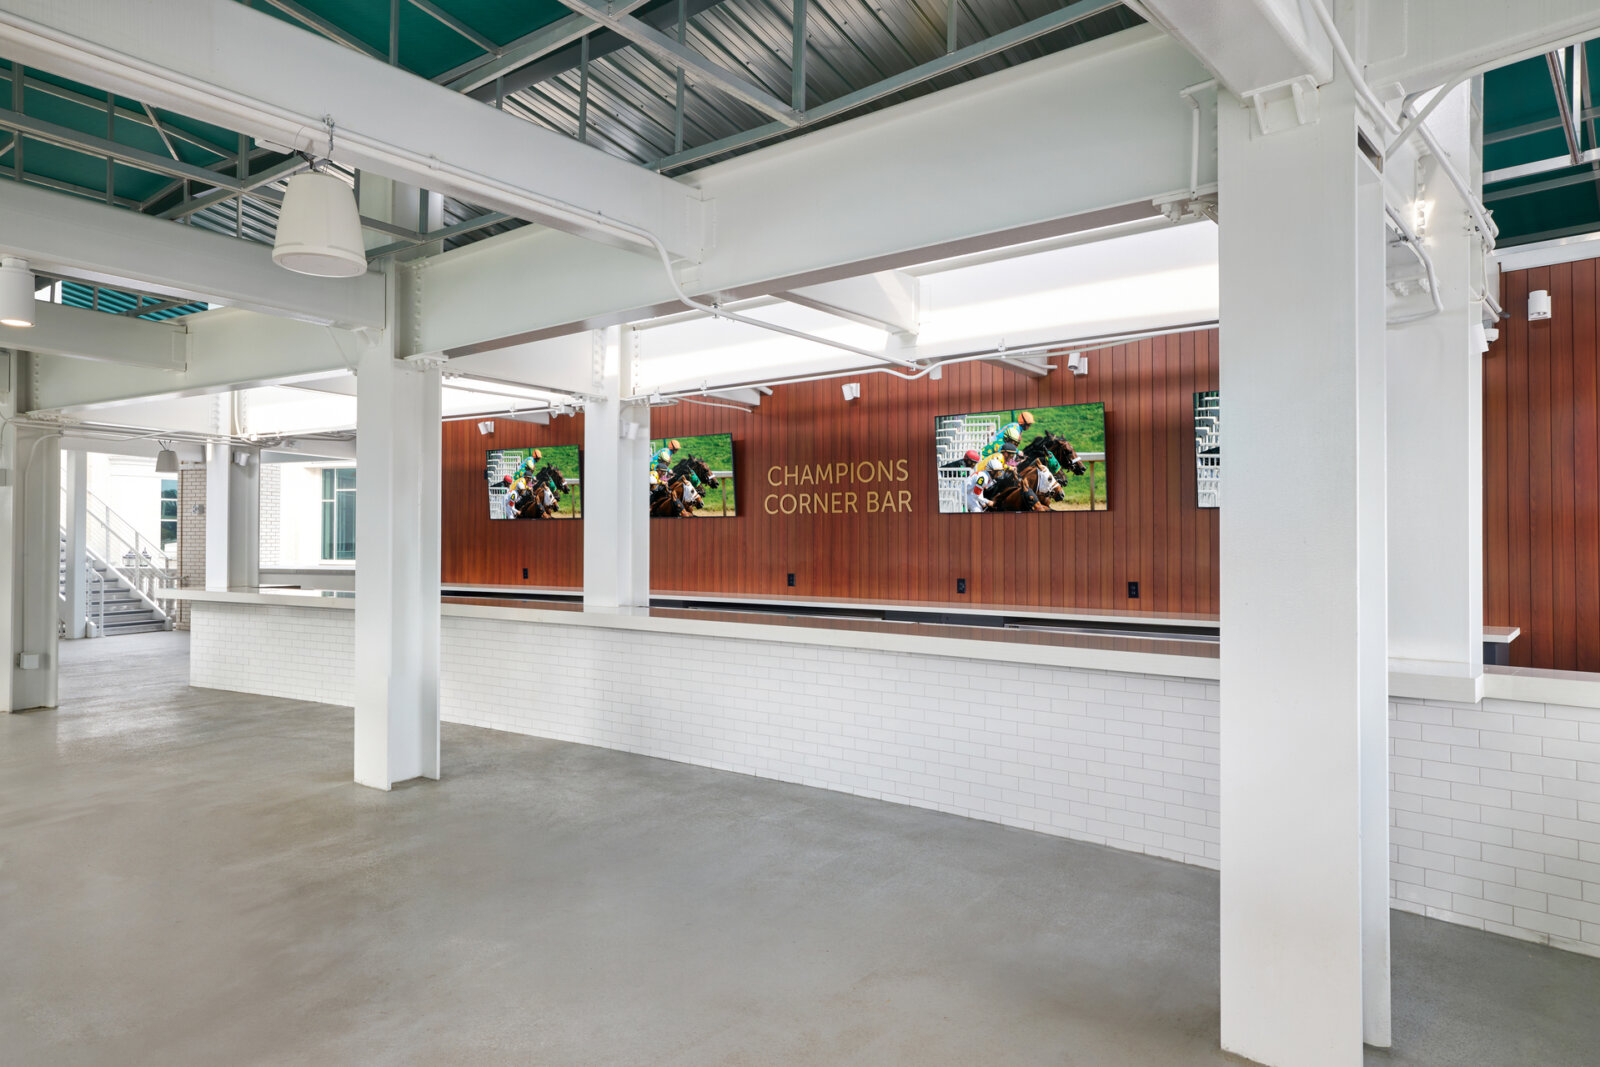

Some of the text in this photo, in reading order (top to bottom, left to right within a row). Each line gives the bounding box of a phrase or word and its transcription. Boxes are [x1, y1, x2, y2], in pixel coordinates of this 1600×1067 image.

[767, 459, 909, 487] CHAMPIONS
[764, 490, 913, 515] CORNER BAR
